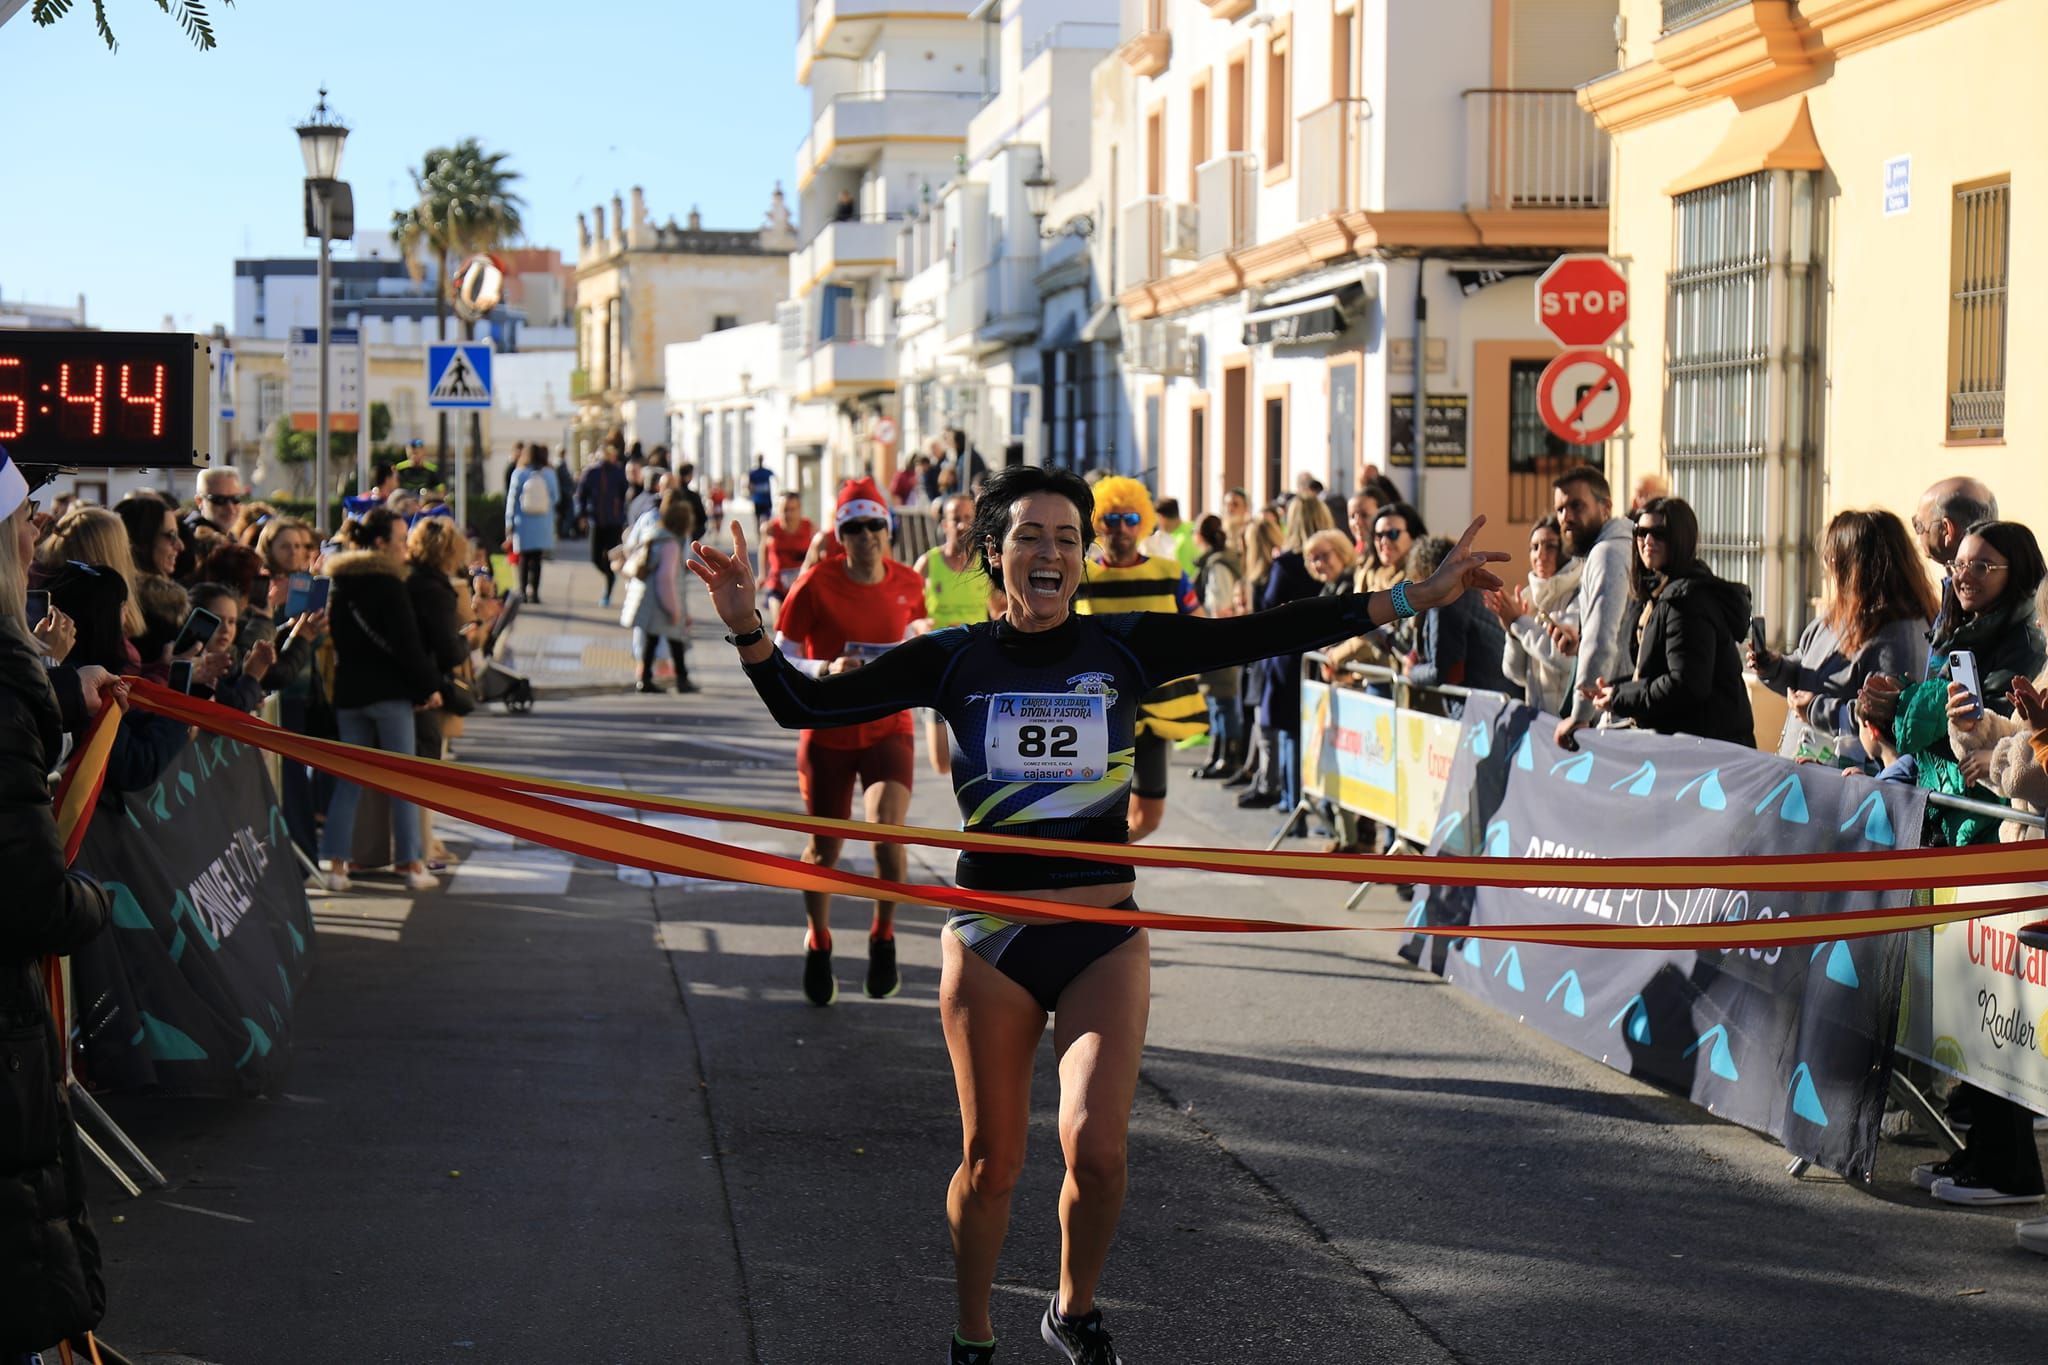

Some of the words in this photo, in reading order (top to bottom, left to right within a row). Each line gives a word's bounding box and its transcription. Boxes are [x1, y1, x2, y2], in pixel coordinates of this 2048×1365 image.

[1543, 290, 1626, 316] STOP
[1020, 706, 1052, 718] DIVINA
[1053, 706, 1092, 719] PASTORA
[1021, 698, 1053, 708] CARRERA
[1054, 698, 1091, 707] SOLIDARIA
[1018, 725, 1078, 758] 82
[1023, 768, 1065, 780] cajasur
[1978, 984, 2036, 1052] Radler
